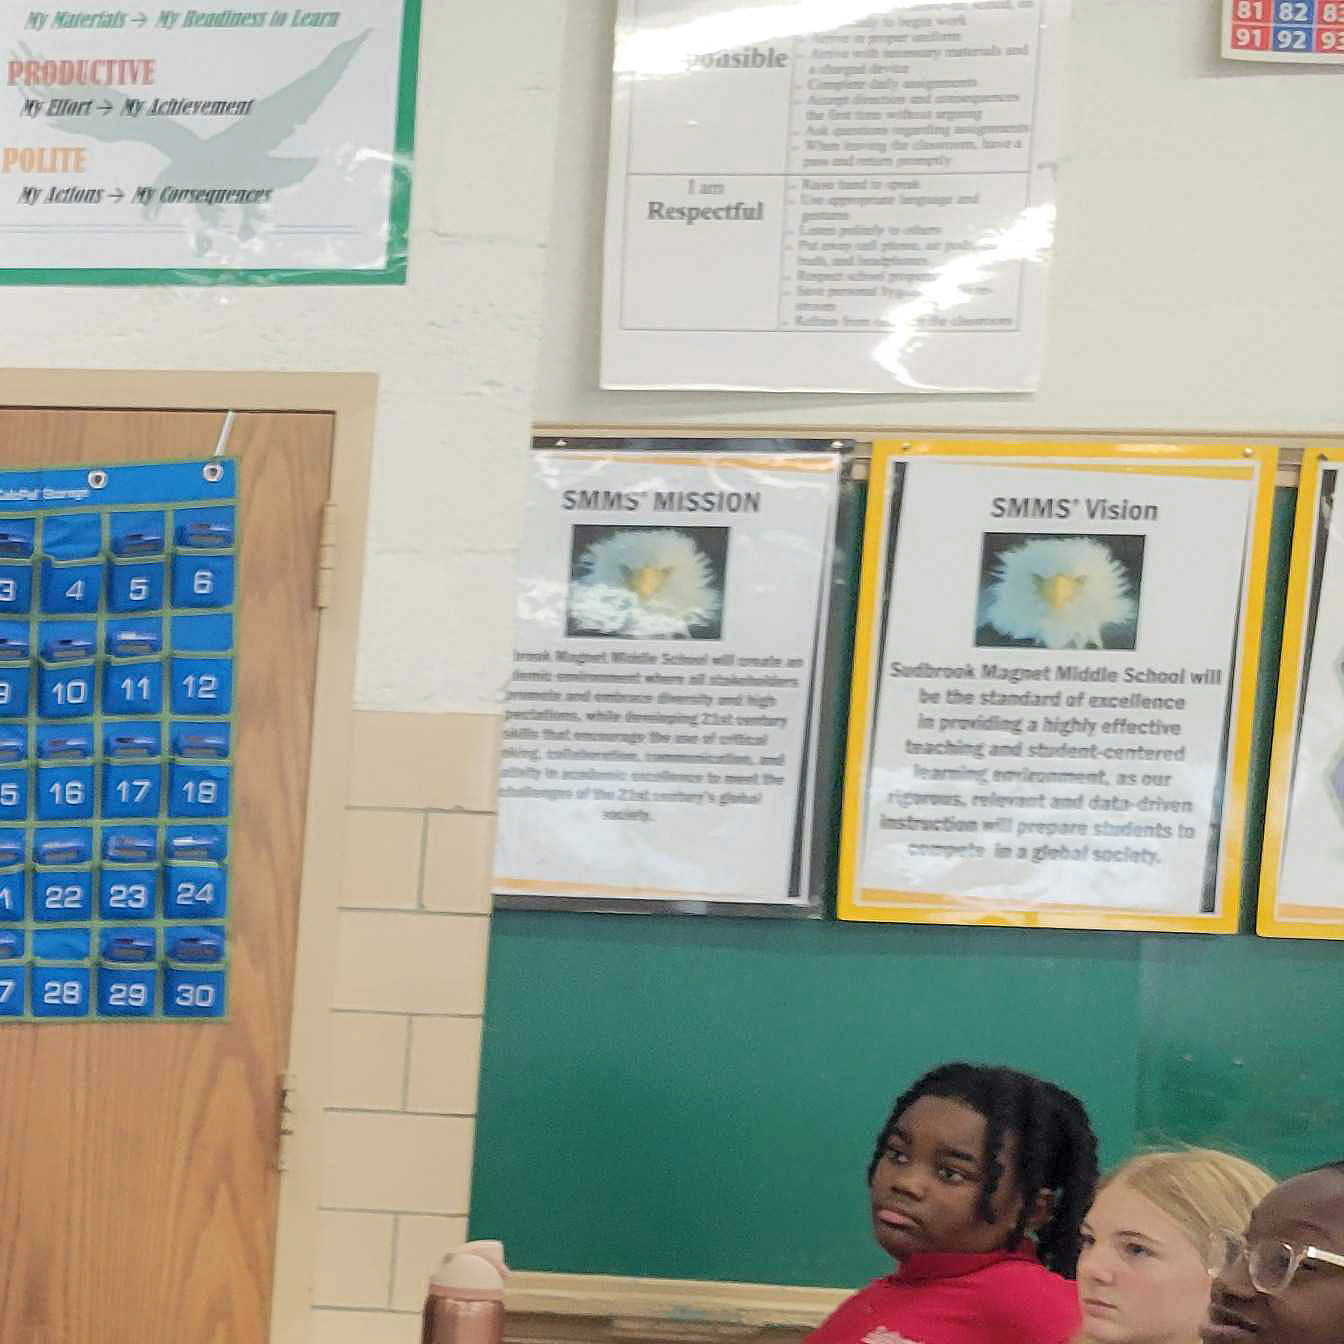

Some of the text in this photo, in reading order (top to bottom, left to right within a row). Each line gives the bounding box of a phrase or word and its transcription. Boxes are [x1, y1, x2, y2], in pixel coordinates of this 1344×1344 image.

[24, 10, 341, 30] My Materials My Readiness to Learn
[1236, 0, 1263, 20] 81
[1279, 2, 1308, 21] 82
[1236, 28, 1262, 48] 91
[1277, 30, 1307, 49] 92
[6, 59, 157, 86] PRODUCTIVE
[20, 98, 255, 119] My Effort My Achievement
[1, 146, 88, 174] POLITE
[17, 186, 275, 206] My Actions My Consequences
[647, 200, 765, 225] Respectful
[653, 490, 761, 513] MISSION
[1084, 497, 1160, 521] Vision
[65, 578, 85, 601] 4
[129, 578, 149, 601] 5
[193, 571, 213, 594] 6
[889, 661, 1223, 686] Sudbrook Magnet Middle School will
[51, 680, 88, 704] 10
[120, 677, 153, 700] 11
[182, 674, 218, 699] 12
[918, 688, 1187, 711] be the standard of excellence
[918, 713, 1182, 737] in providing a highly effective
[905, 739, 1187, 762] teaching and student-centered
[913, 763, 990, 785] learning
[1115, 773, 1137, 786] as
[1140, 773, 1173, 787] our
[48, 781, 85, 805] 16
[116, 779, 153, 803] 17
[182, 780, 218, 804] 18
[971, 792, 1045, 808] relevant
[1049, 795, 1084, 811] and
[1088, 795, 1194, 813] data-driven
[879, 814, 1197, 840] instruction will prepare students to
[908, 842, 987, 862] compete
[1030, 844, 1089, 864] global
[44, 886, 84, 909] 22
[108, 884, 148, 909] 23
[175, 882, 214, 906] 24
[43, 980, 82, 1004] 28
[108, 983, 147, 1007] 29
[175, 983, 215, 1007] 30
